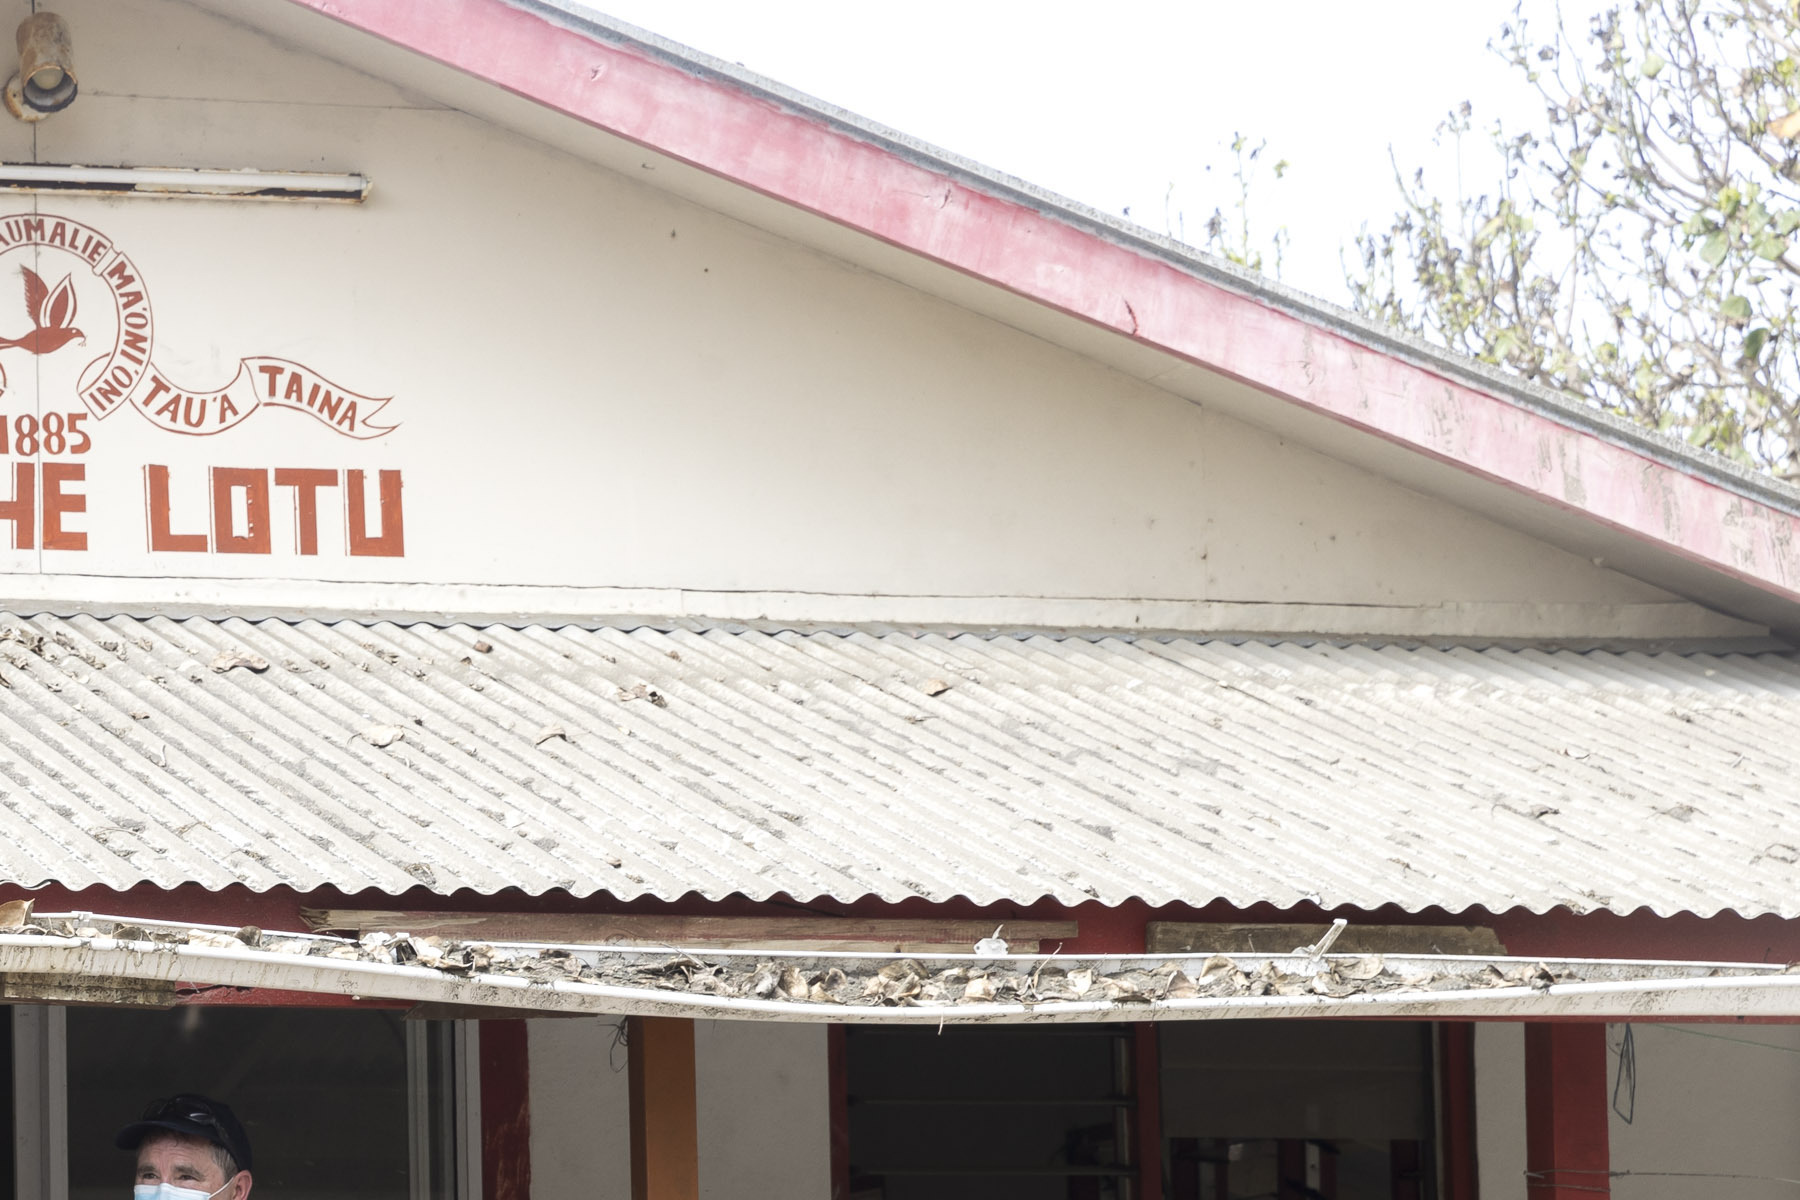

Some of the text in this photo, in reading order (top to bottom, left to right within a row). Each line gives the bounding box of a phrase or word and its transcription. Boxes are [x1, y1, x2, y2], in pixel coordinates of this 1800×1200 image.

[142, 375, 239, 428] TAU'A
[259, 365, 357, 432] TAINA
[143, 464, 406, 557] LOTU
